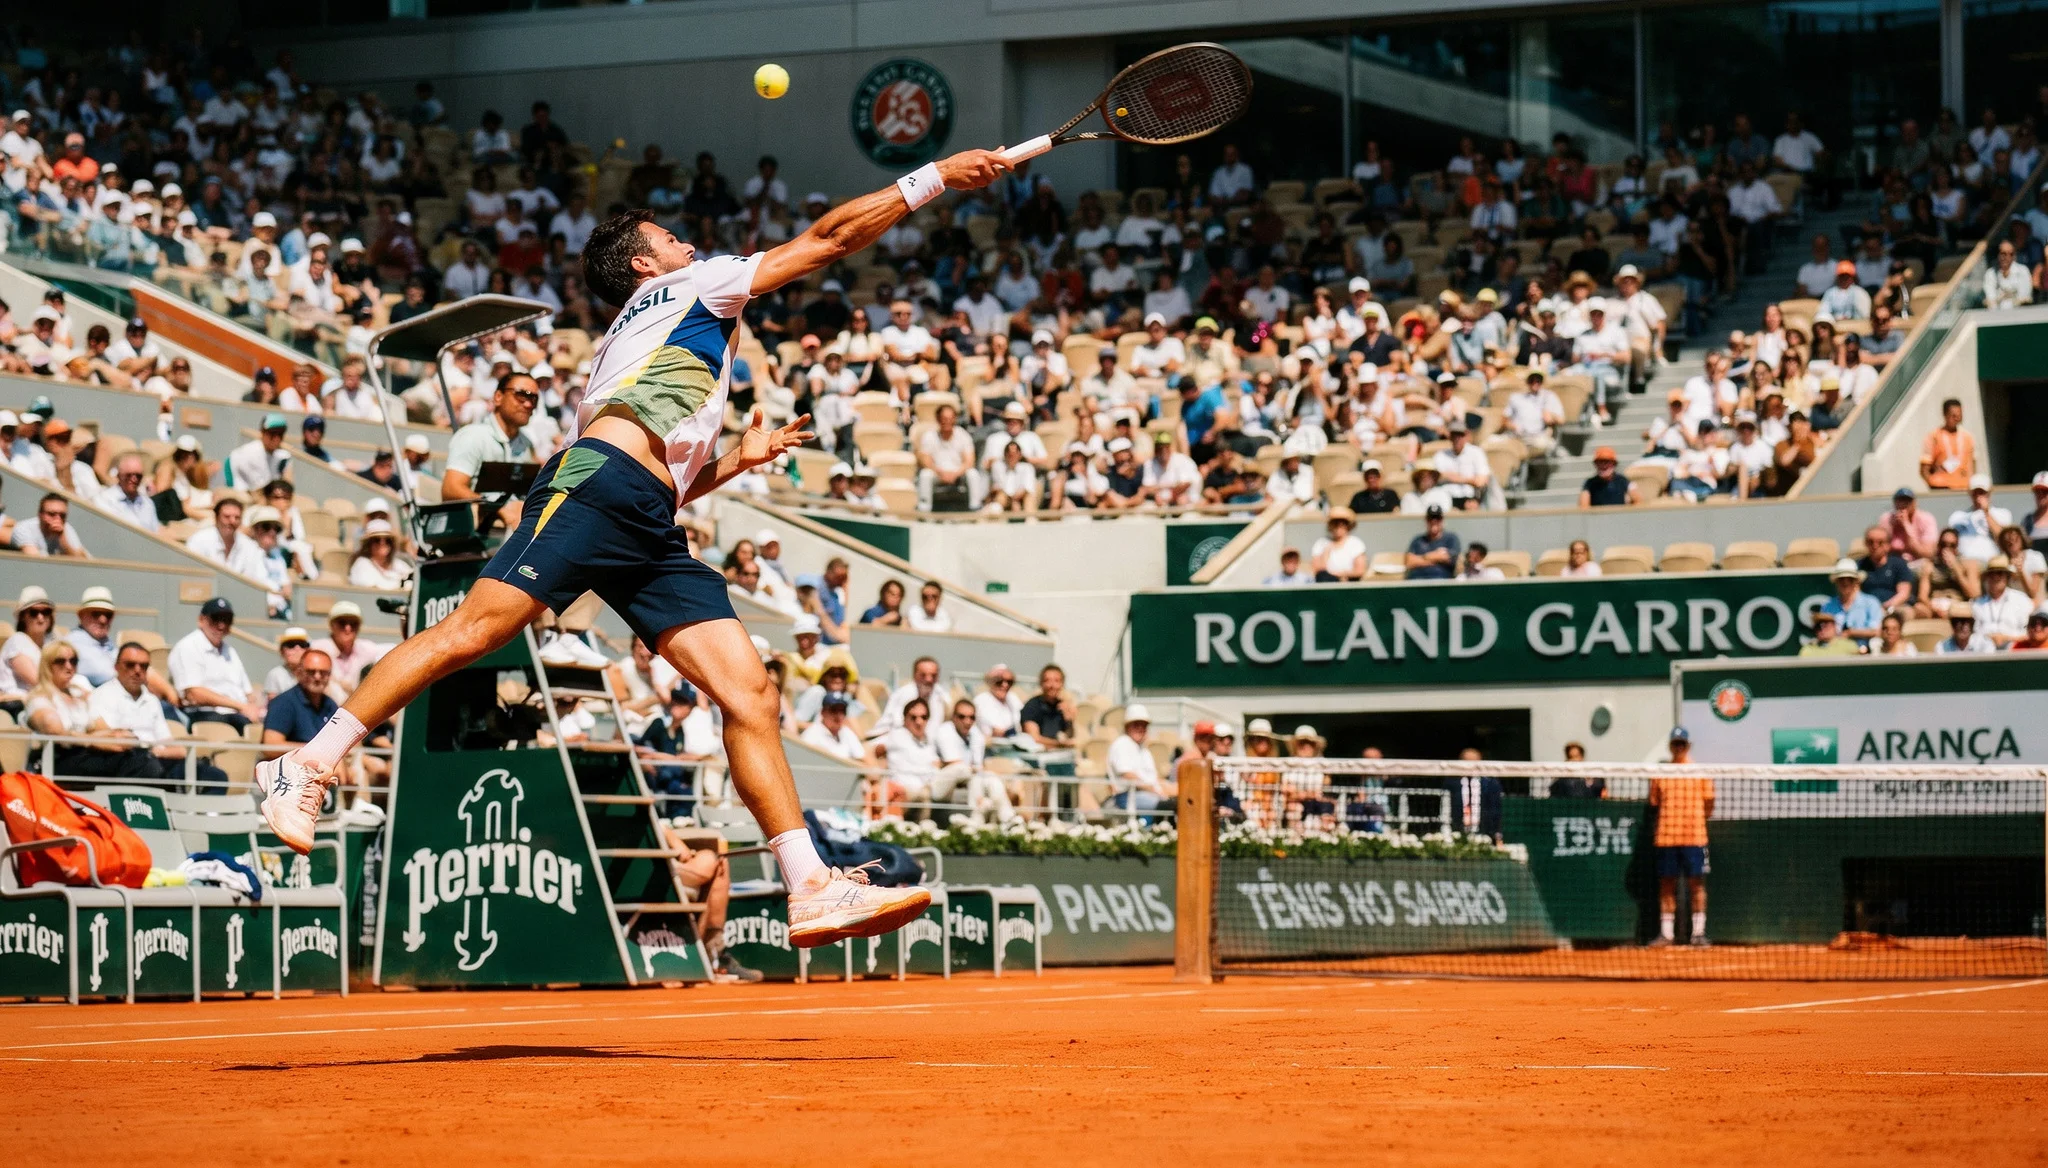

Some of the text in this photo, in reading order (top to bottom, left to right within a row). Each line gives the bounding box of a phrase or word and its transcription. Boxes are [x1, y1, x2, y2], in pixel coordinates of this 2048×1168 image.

[1193, 594, 1831, 664] ROLAND GARROS
[1856, 727, 2021, 765] ARANÇA
[1552, 816, 1635, 857] IBM
[403, 826, 583, 953] perrier
[1052, 884, 1175, 934] PARIS
[1339, 880, 1396, 927] NO
[0, 913, 64, 965] rrier
[134, 919, 189, 980] perrier
[281, 918, 338, 977] perrier
[723, 908, 792, 952] errier
